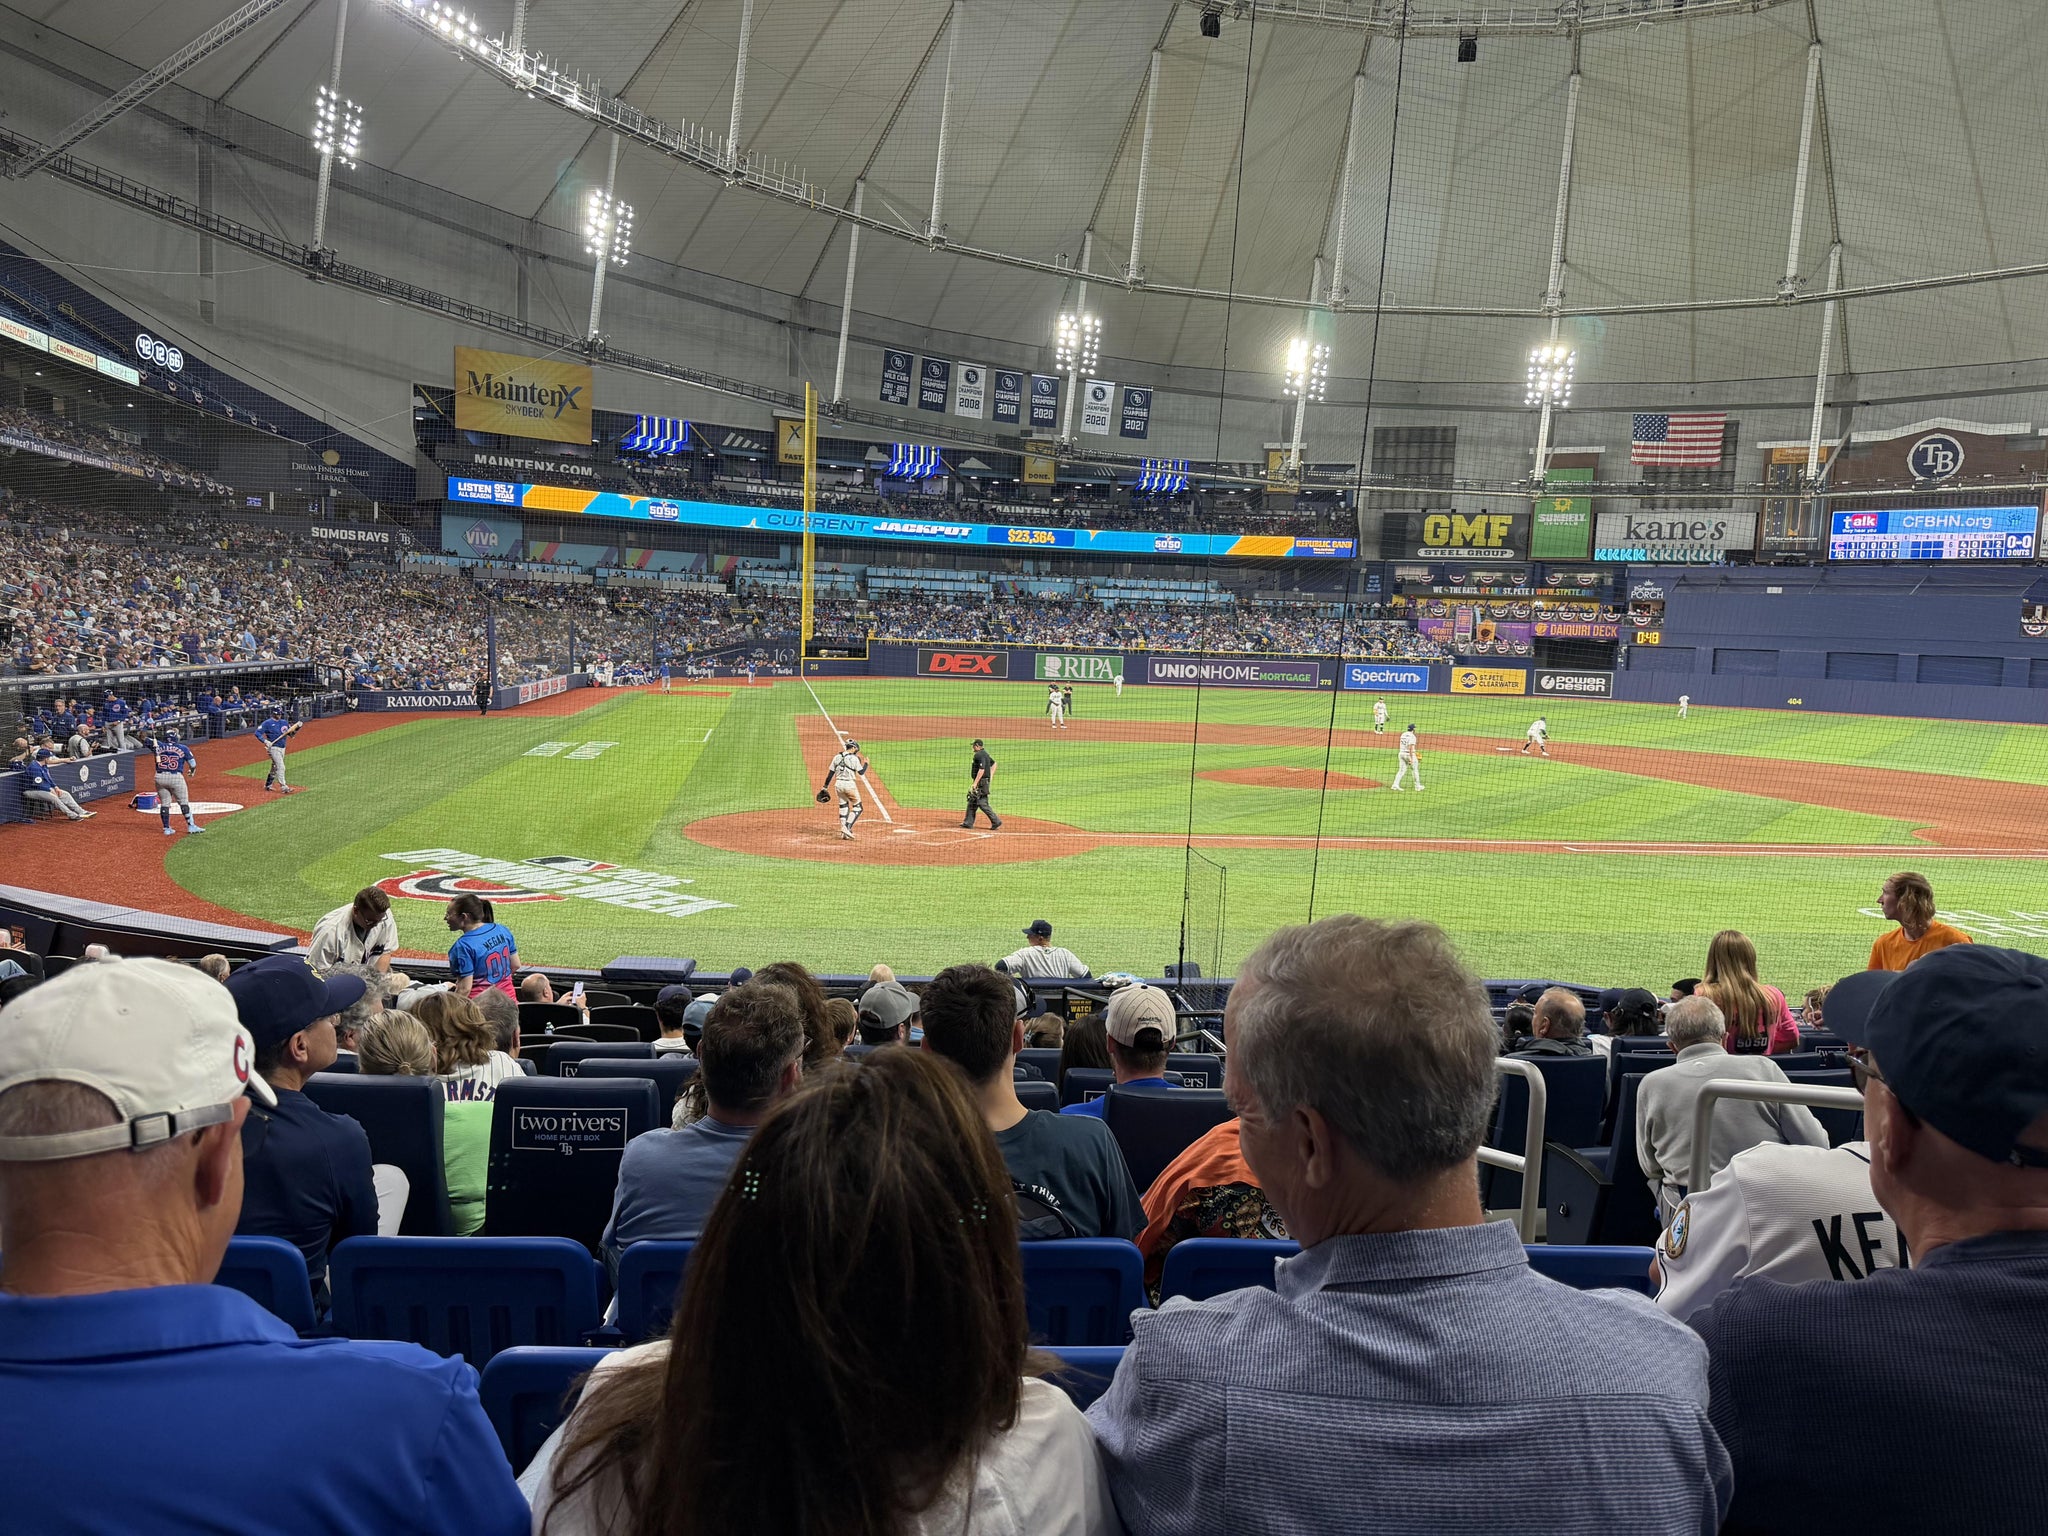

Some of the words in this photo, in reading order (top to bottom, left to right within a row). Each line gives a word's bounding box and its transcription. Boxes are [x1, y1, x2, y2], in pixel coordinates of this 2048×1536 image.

[138, 337, 150, 354] 42
[155, 346, 165, 362] 12
[169, 355, 181, 369] 66
[466, 370, 583, 419] MaintenX
[922, 391, 943, 404] 2008
[960, 398, 980, 409] 2008
[997, 403, 1016, 415] 2010
[505, 404, 545, 418] SKYDECK
[1033, 408, 1054, 420] 2020
[1085, 414, 1107, 426] 2020
[1125, 420, 1144, 431] 2021
[475, 454, 592, 476] MAINTENX.COM
[1919, 443, 1954, 473] TB
[292, 462, 317, 472] DREAM
[318, 465, 345, 475] FINDERS
[346, 468, 369, 477] HOMES
[316, 472, 346, 482] TERRACE
[458, 482, 491, 493] LISTEN
[494, 484, 514, 493] 95.7
[470, 492, 492, 500] SEASON
[767, 514, 869, 532] CURRENT
[873, 521, 972, 539] JACKPOT
[1623, 515, 1727, 541] kane's
[1843, 516, 1876, 529] talk
[1903, 515, 1992, 529] CFBHN.org
[311, 527, 356, 540] SOMOS
[358, 531, 389, 542] RAYS
[1423, 514, 1512, 547] GMF
[466, 531, 498, 546] VIVA
[1296, 540, 1331, 548] REPUBLIC
[2007, 535, 2032, 549] 0-0
[1631, 591, 1664, 599] PORCH
[1428, 626, 1454, 635] FAVORITE
[1550, 624, 1590, 636] DAIQUIRI
[1593, 625, 1617, 637] DECK
[1637, 632, 1660, 644] 0:48
[928, 653, 997, 673] DEX
[1064, 657, 1114, 679] RIPA
[1351, 668, 1417, 685] Spectrum
[387, 695, 451, 707] RAYMOND
[452, 695, 492, 707] JAMS
[158, 756, 179, 770] 25
[483, 934, 505, 951] MEGAN
[485, 945, 512, 984] 01
[234, 1035, 250, 1083] C
[1183, 1077, 1204, 1087] ers
[520, 1113, 557, 1131] two
[561, 1112, 621, 1132] rivers
[559, 1142, 573, 1156] TB
